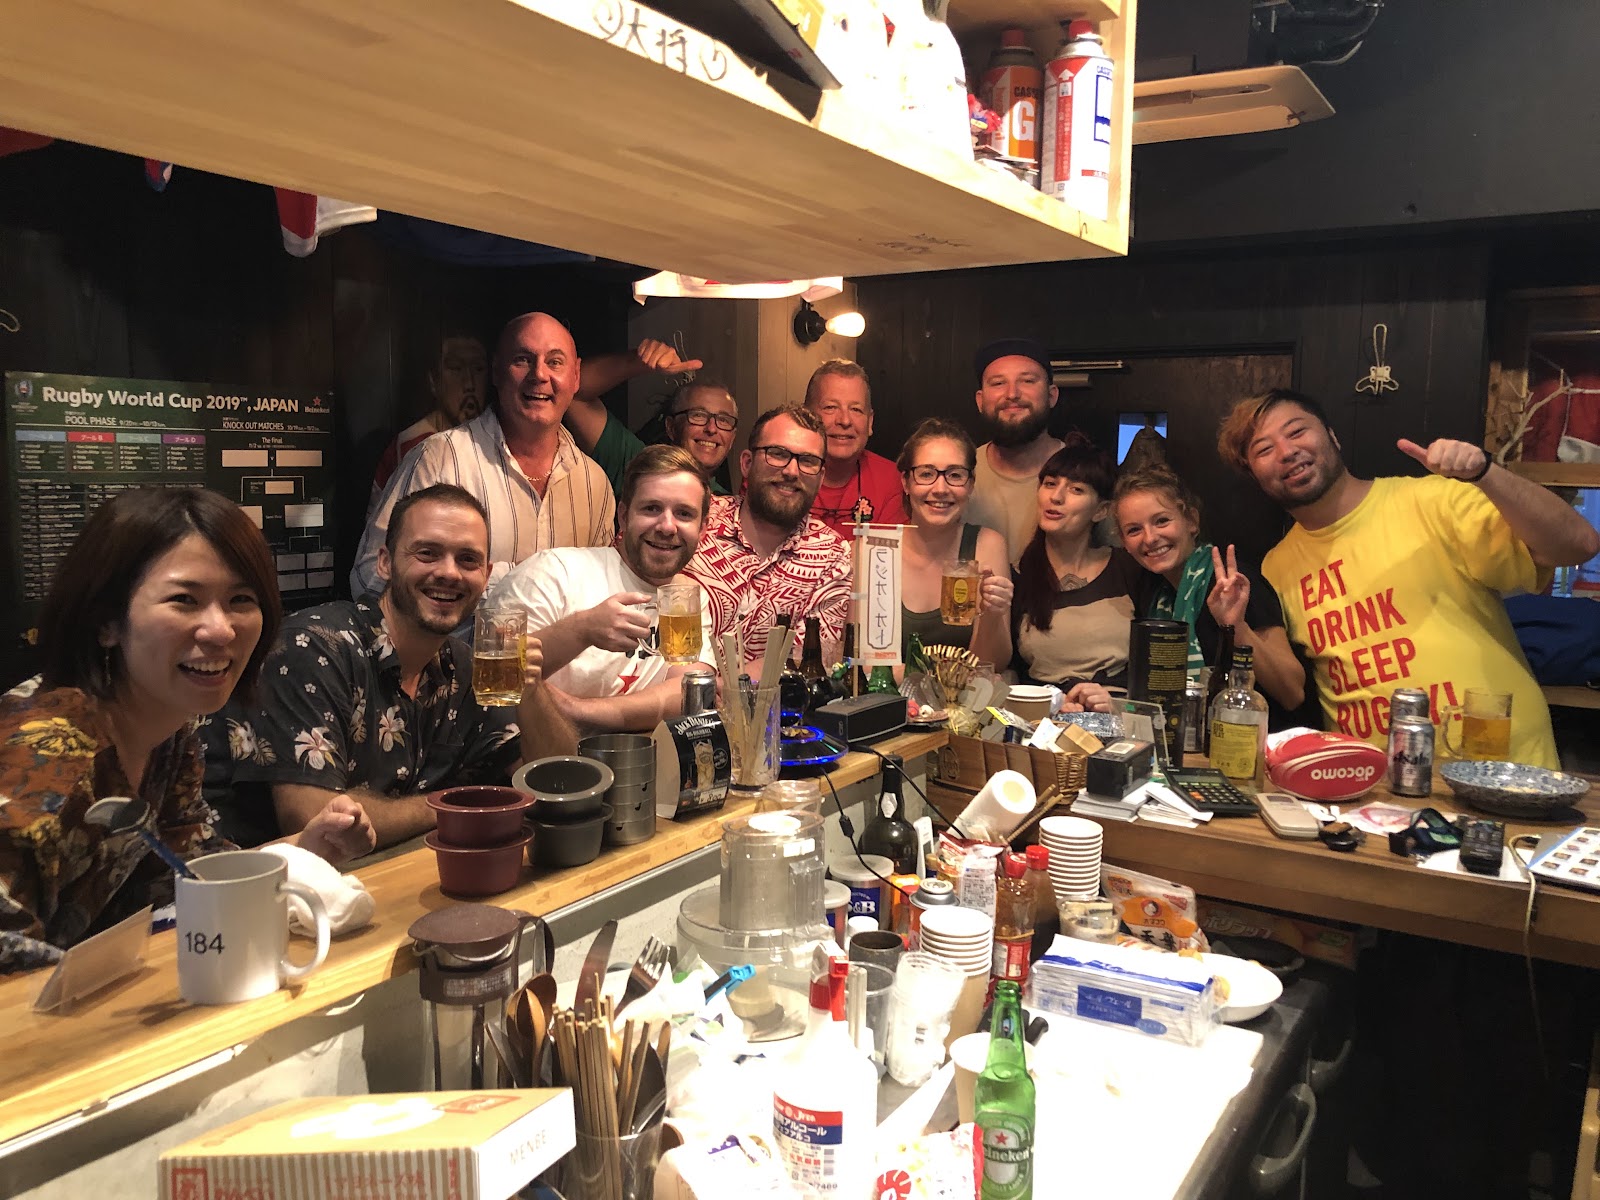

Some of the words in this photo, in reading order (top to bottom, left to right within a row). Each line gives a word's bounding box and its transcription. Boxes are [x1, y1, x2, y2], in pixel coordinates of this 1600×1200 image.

[42, 386, 104, 409] Rugby
[107, 389, 164, 407] World
[168, 394, 203, 412] Cup
[253, 398, 299, 413] JAPAN
[304, 406, 330, 414] Heineken
[64, 416, 89, 426] POOL
[90, 417, 117, 427] PHASE
[222, 421, 244, 430] KNOCK
[245, 422, 258, 430] OUT
[258, 422, 285, 431] MATCHES
[1300, 559, 1348, 611] EAT
[1307, 587, 1407, 656] DRINK
[1328, 637, 1417, 696] SLEEP
[1337, 681, 1463, 740] RUGY!
[674, 718, 691, 735] JACK
[1311, 765, 1375, 781] docomo
[185, 932, 225, 955] 184
[983, 1145, 1030, 1162] ineken
